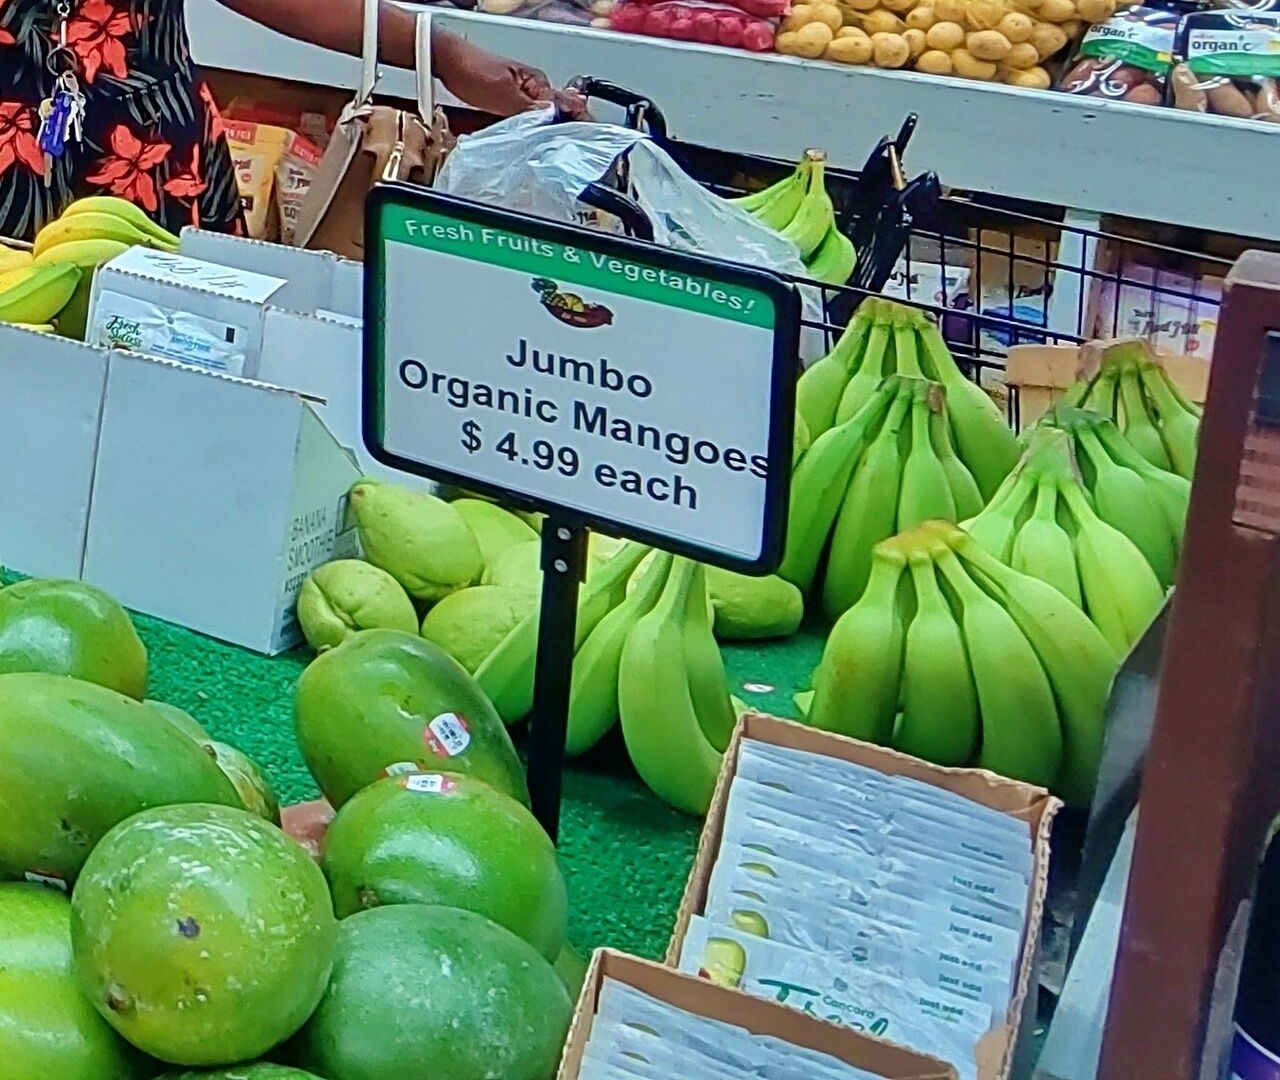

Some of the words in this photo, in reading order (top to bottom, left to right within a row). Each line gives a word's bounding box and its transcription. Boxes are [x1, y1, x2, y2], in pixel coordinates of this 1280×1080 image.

[404, 218, 475, 244] Fresh
[481, 228, 555, 259] Fruits
[562, 244, 581, 265] &
[588, 251, 756, 315] Vegetables!
[506, 338, 654, 399] Jumbo
[398, 358, 559, 424] Organic
[573, 400, 770, 480] Mangoes
[461, 419, 482, 456] $
[495, 430, 580, 478] 4.99
[594, 465, 698, 510] each
[288, 528, 334, 572] SMOOTHIE
[292, 506, 327, 542] BANANA
[823, 995, 876, 1020] Concord
